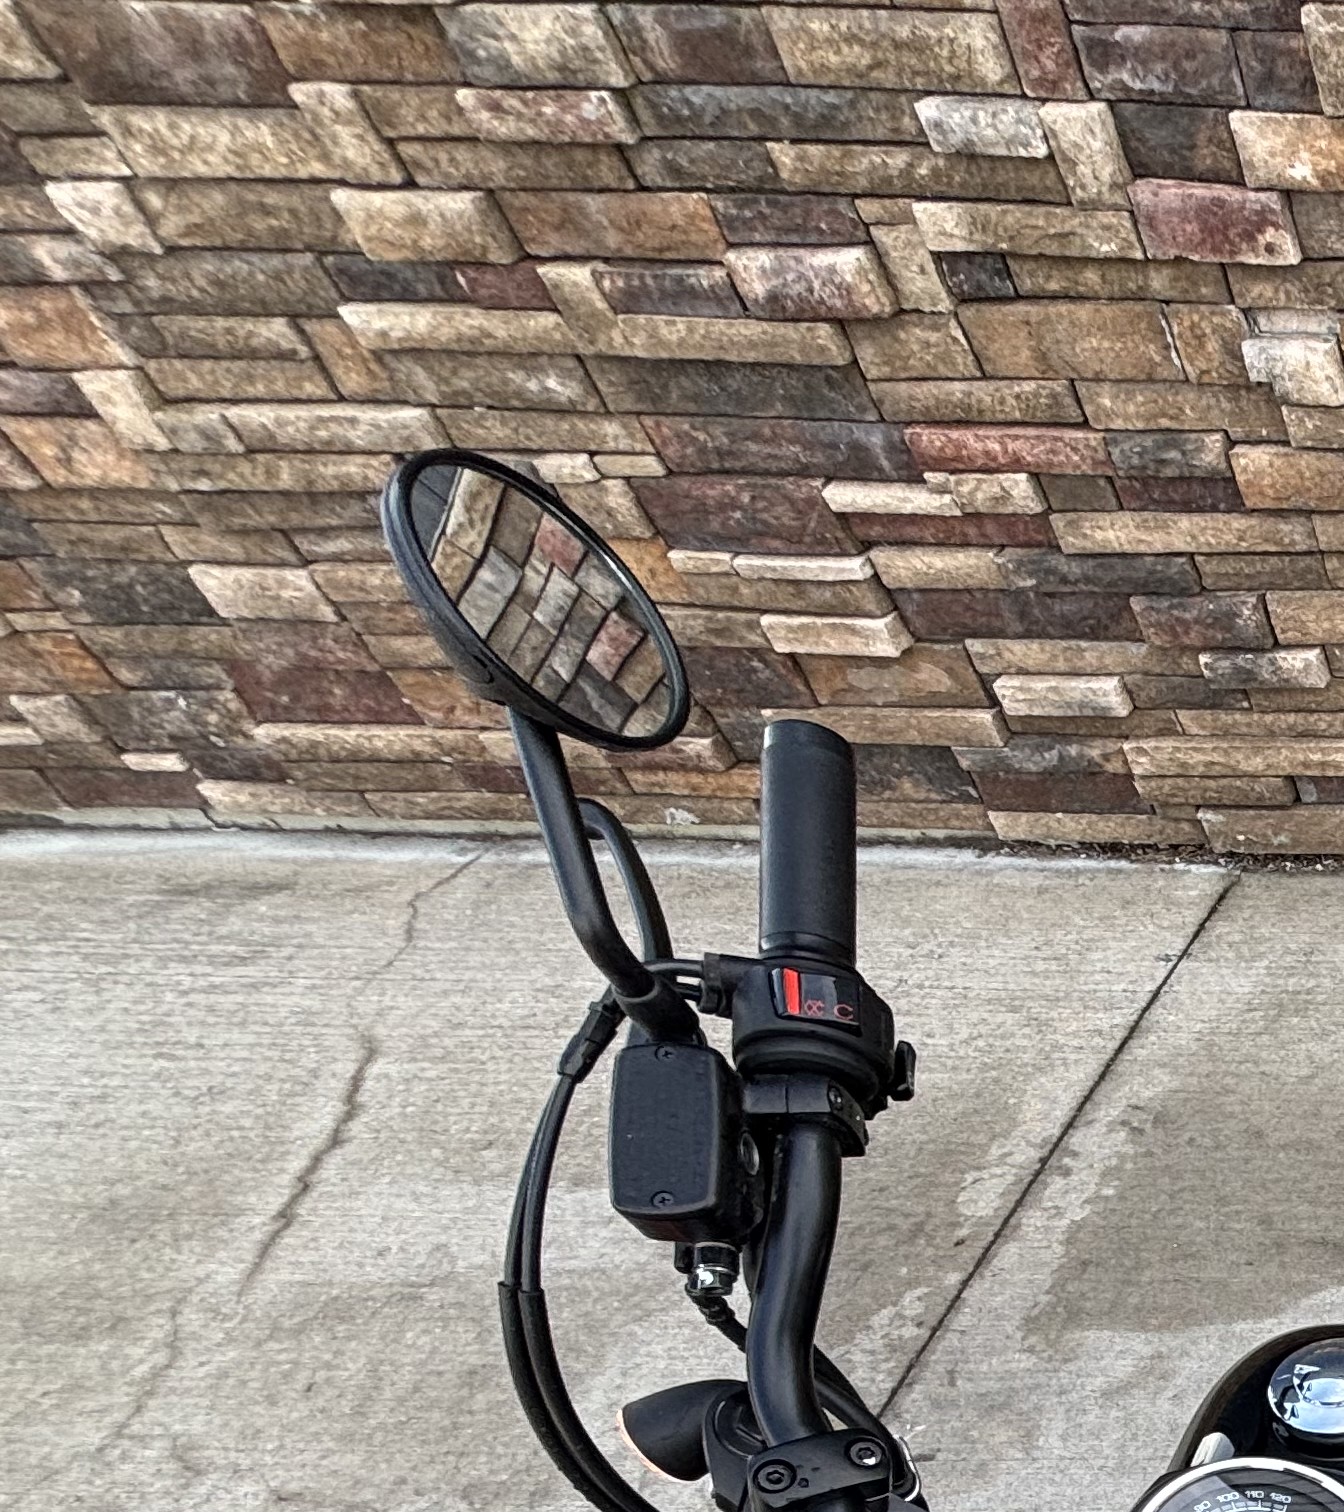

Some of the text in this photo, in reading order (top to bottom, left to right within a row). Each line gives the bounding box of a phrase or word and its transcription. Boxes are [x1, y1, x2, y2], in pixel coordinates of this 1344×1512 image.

[1216, 1491, 1239, 1502] 100
[1269, 1493, 1291, 1503] 120
[1193, 1500, 1211, 1512] 90
